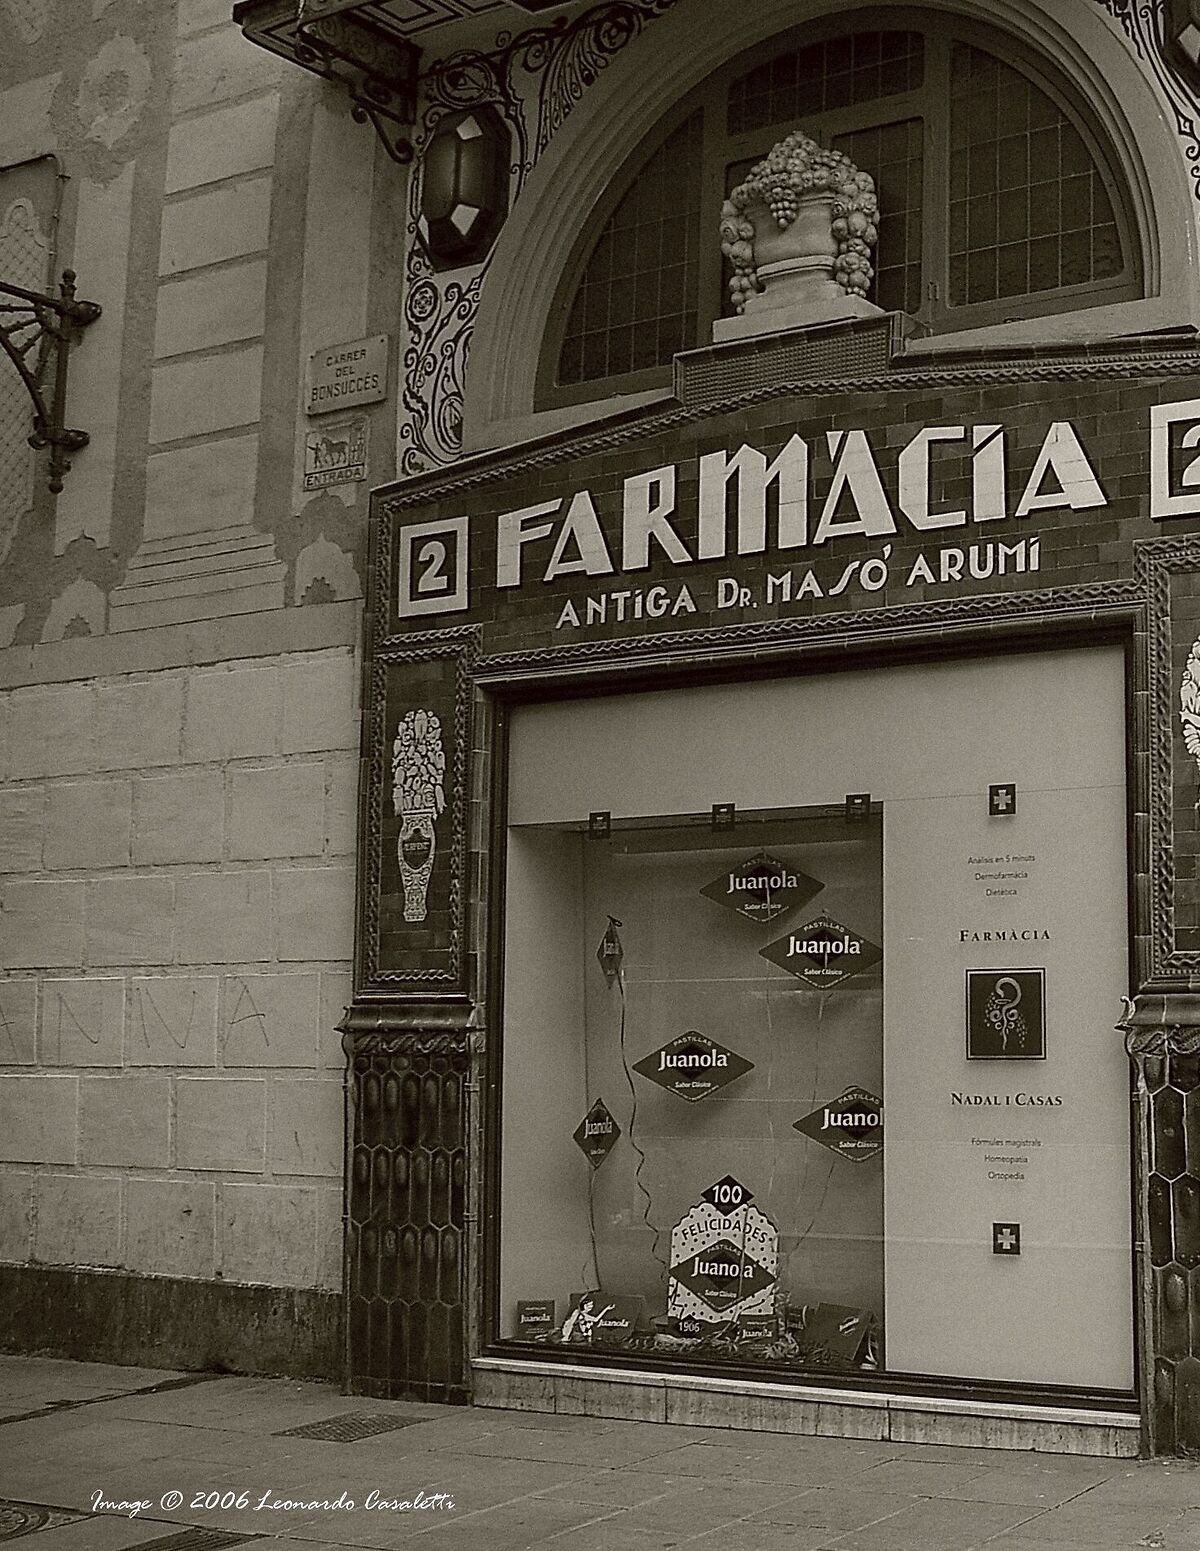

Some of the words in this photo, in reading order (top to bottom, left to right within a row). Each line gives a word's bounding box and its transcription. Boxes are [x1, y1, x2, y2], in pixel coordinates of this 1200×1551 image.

[325, 348, 368, 367] CARRER
[335, 365, 356, 378] DEL
[306, 467, 361, 486] ENTRADA
[417, 540, 449, 594] 2
[766, 543, 893, 605] MASÓ
[727, 870, 798, 894] Juanola
[786, 935, 861, 958] Juanola
[657, 1048, 728, 1071] Juanola
[950, 1092, 1002, 1107] NADAL
[1014, 1092, 1064, 1107] CASAS
[820, 1106, 884, 1130] Juanol
[711, 1184, 744, 1204] 100
[681, 1218, 769, 1244] FELICIDADES
[690, 1256, 754, 1278] Juanoa
